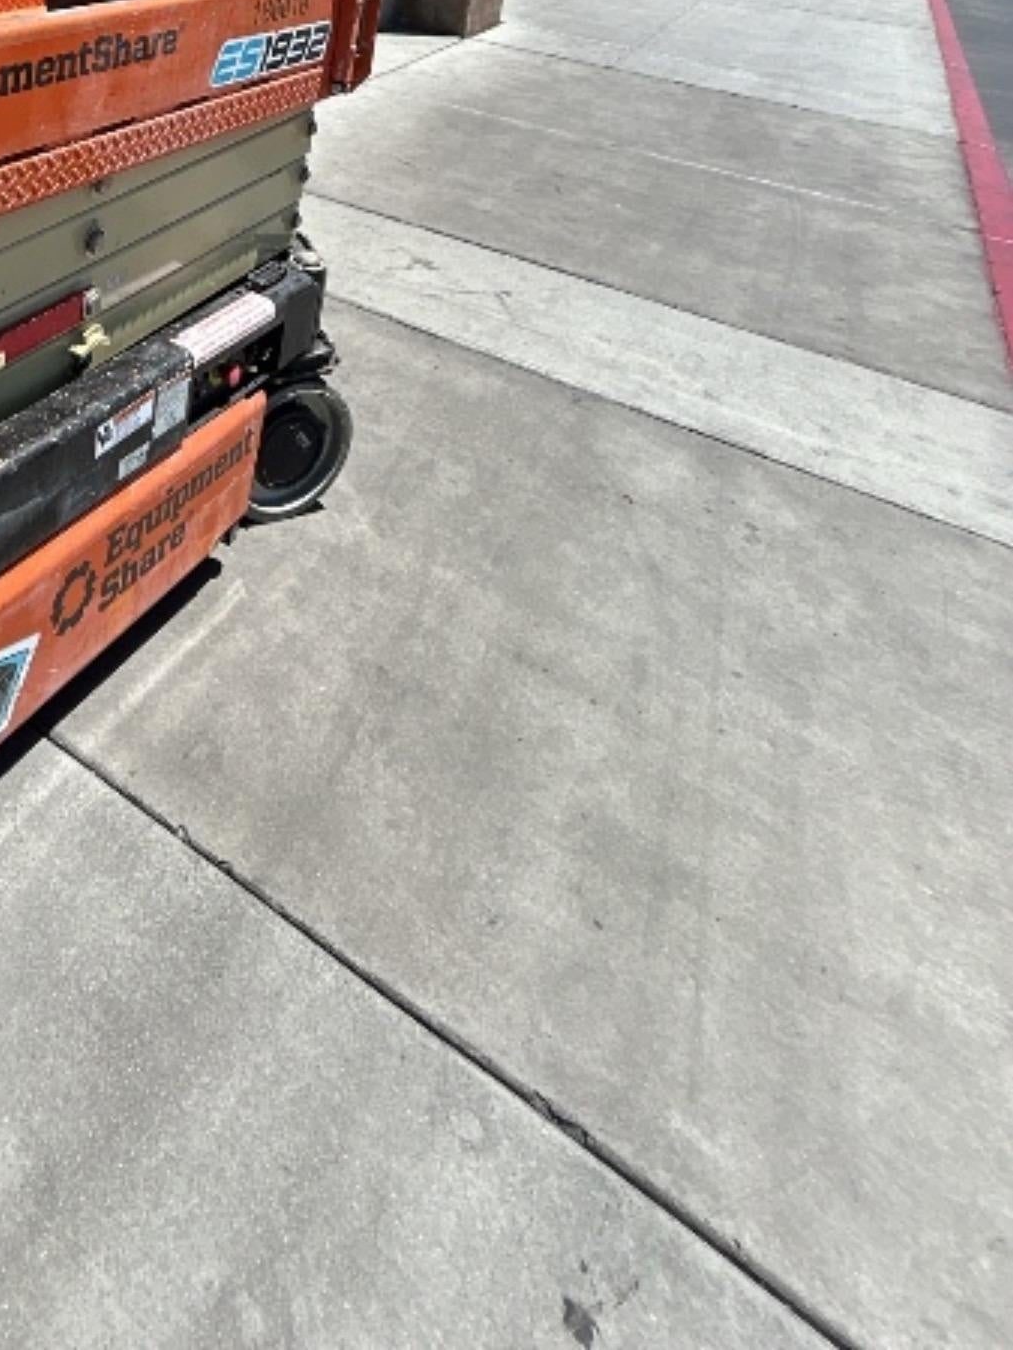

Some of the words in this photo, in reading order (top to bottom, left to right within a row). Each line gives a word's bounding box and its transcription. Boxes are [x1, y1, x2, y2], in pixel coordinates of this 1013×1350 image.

[210, 21, 331, 87] ES1932
[104, 427, 257, 568] Equipment
[97, 521, 186, 613] Share
